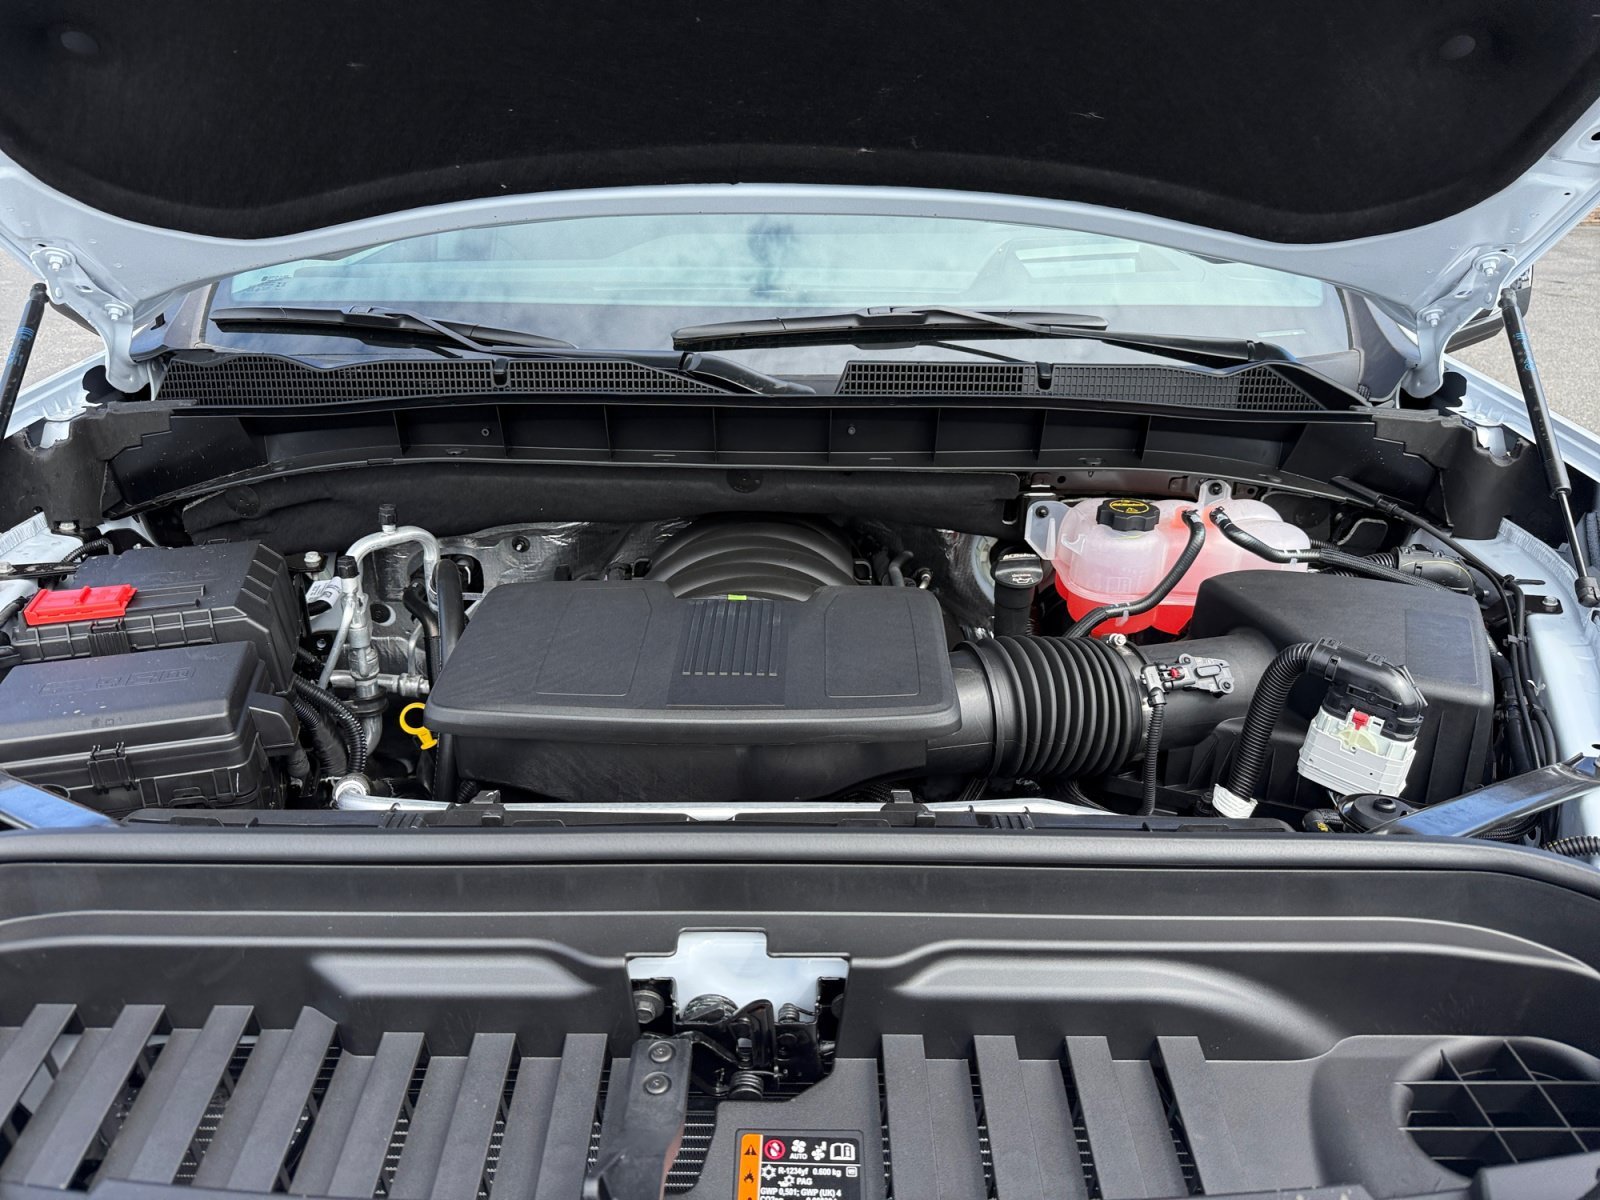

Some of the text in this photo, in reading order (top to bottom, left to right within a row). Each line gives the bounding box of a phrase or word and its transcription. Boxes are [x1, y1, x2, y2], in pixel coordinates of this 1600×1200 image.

[789, 1152, 808, 1160] AUTO
[777, 1166, 809, 1176] R-1234yf
[832, 1168, 842, 1178] kg
[796, 1177, 813, 1185] PAG
[760, 1187, 778, 1195] GWP
[800, 1188, 819, 1196] GWP
[819, 1188, 836, 1199] (UK)
[836, 1188, 842, 1197] 4
